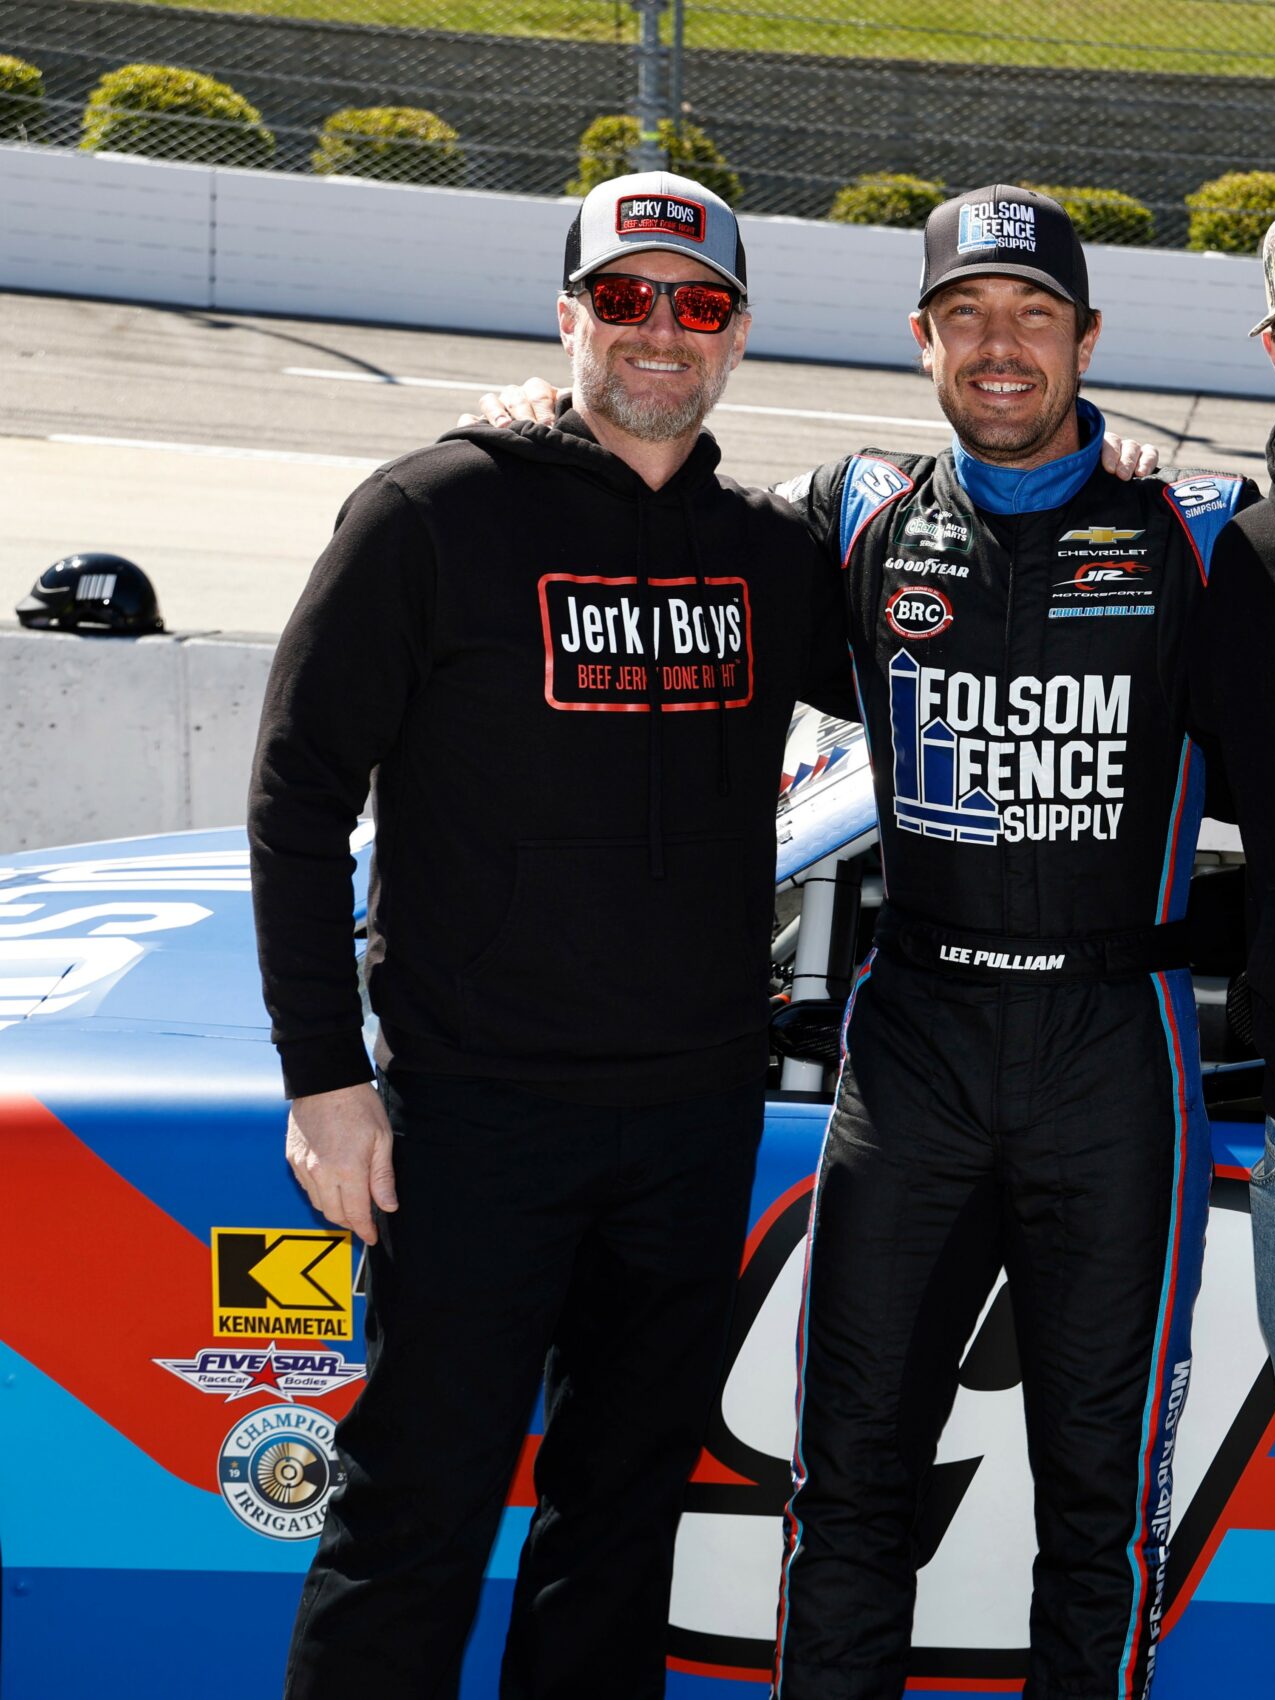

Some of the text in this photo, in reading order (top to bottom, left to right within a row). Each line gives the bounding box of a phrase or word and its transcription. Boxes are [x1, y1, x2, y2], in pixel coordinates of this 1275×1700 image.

[629, 200, 694, 223] Jerky Boys
[971, 202, 1034, 223] FOLSOM
[982, 219, 1035, 240] FENCE
[998, 237, 1036, 252] SUPPLY
[1185, 501, 1224, 519] SIMPSON
[904, 517, 968, 540] O'Reill AUTO
[1057, 549, 1148, 557] CHEVROLET
[884, 557, 969, 578] GOODYEAR
[896, 601, 941, 622] BRC
[667, 598, 741, 659] Boys
[578, 664, 735, 690] BEEF JER DONE RIHT
[920, 667, 1131, 737] FOLSOM
[959, 737, 1127, 801] FENCE
[1003, 803, 1124, 843] SUPPLY
[940, 944, 1065, 971] LEE PULLIAM
[219, 1316, 348, 1336] KENNAMETAL
[200, 1354, 339, 1376] FIVE STAR
[198, 1374, 328, 1386] RaceCar Bodies
[235, 1413, 337, 1453] CHAMPION
[229, 1469, 241, 1478] 19
[234, 1489, 328, 1532] IRRIGATI
